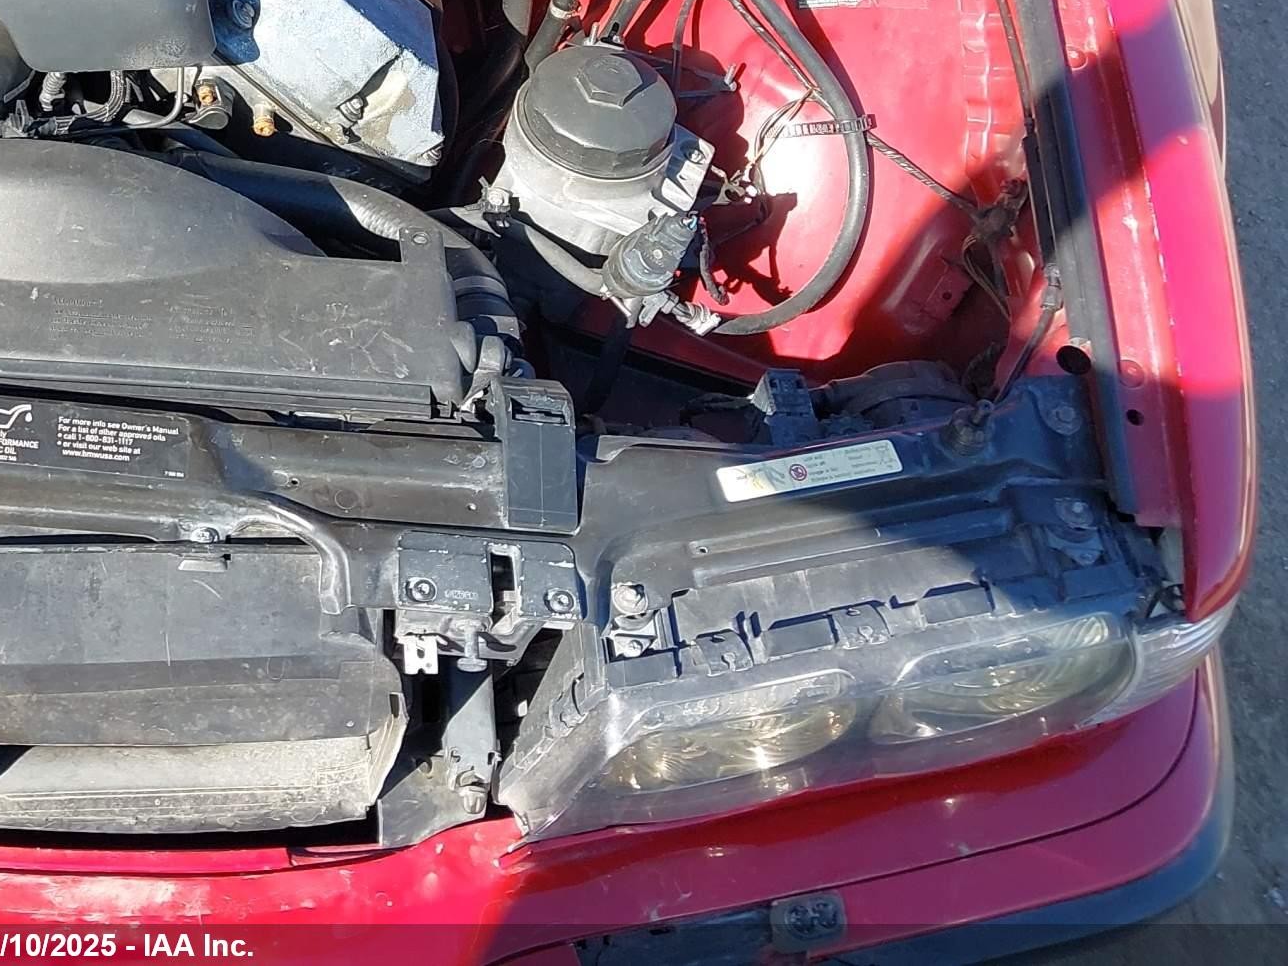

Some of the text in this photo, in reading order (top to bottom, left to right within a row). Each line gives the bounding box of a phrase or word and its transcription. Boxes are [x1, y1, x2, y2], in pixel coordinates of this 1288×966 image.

[72, 418, 91, 426] more
[152, 425, 179, 435] Manual
[98, 428, 118, 436] other
[118, 430, 152, 440] approved
[4, 446, 17, 454] OIL
[72, 441, 87, 449] visit
[118, 446, 132, 454] site
[62, 449, 130, 461] www.bmwusa.com
